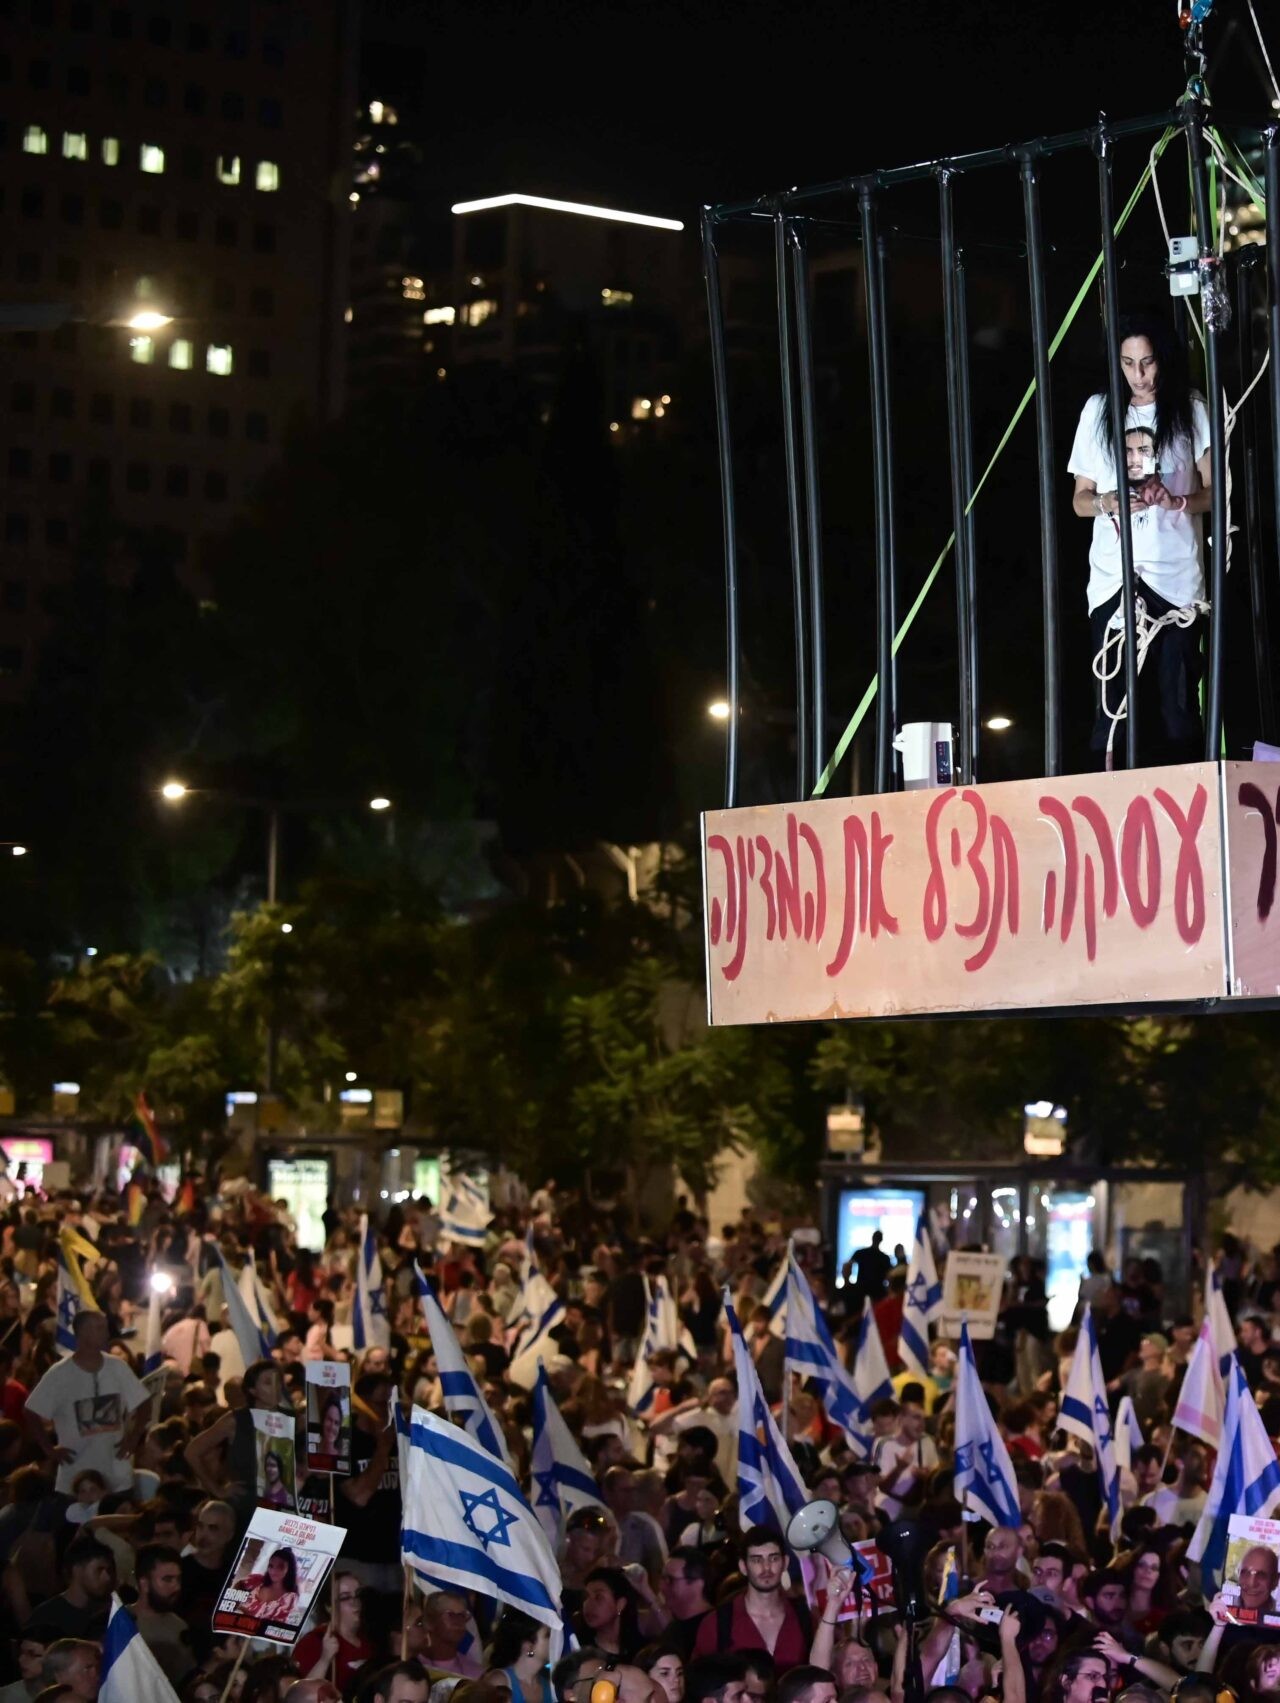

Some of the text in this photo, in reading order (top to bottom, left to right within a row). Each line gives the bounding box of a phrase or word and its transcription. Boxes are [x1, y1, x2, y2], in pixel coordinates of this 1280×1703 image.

[708, 783, 1209, 981] עסקה תציל את המדינה
[224, 1588, 250, 1602] BRING
[218, 1600, 237, 1612] HER
